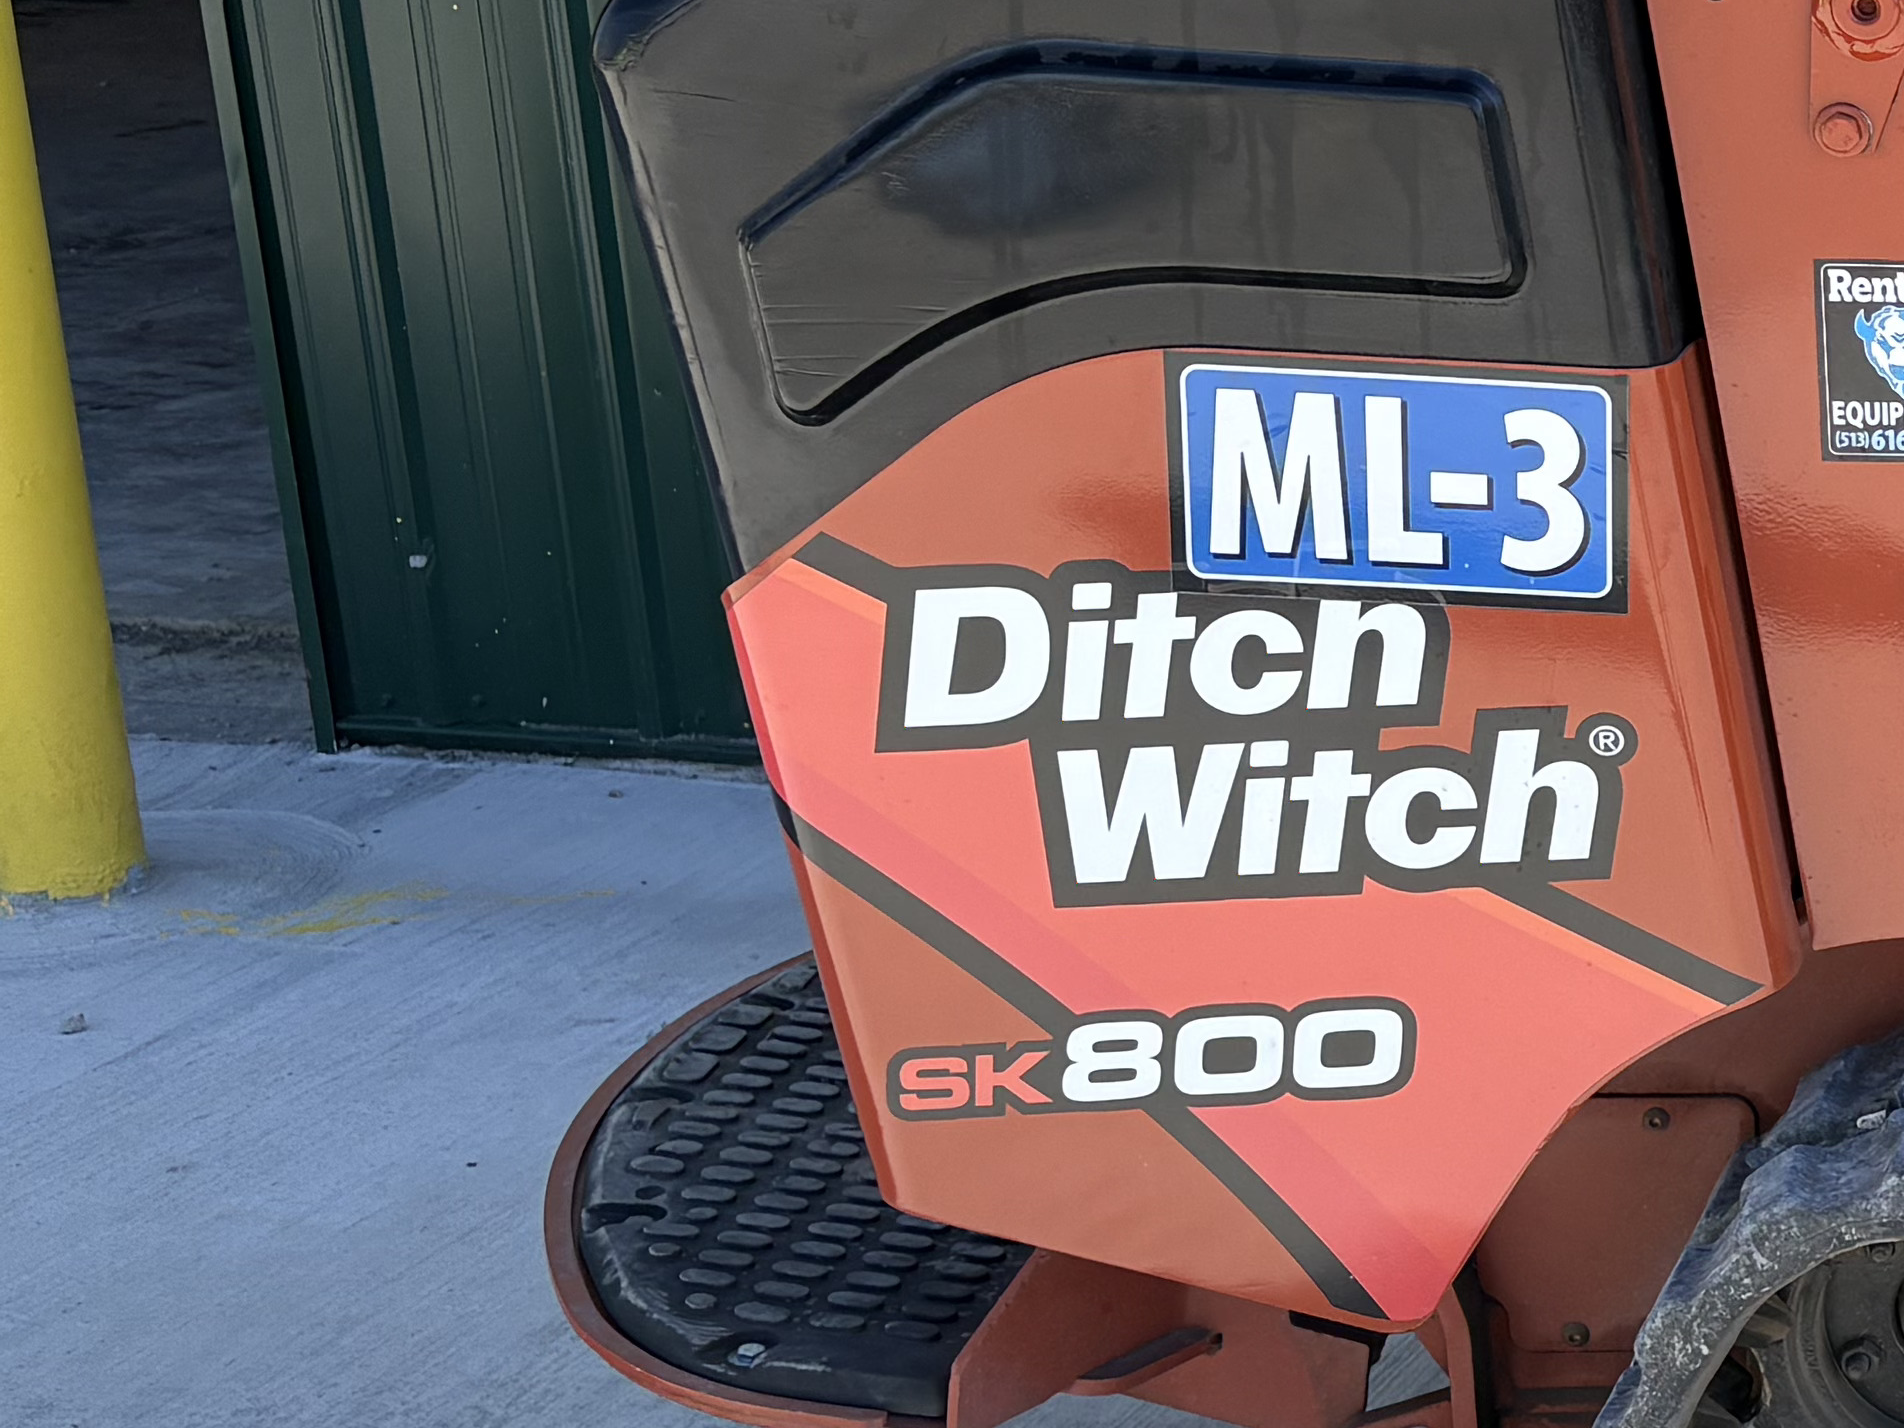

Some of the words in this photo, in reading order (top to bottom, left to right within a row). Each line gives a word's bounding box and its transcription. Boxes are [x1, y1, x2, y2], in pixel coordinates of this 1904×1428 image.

[1208, 387, 1592, 574] ML-3
[1835, 430, 1870, 449] (513)
[899, 1008, 1404, 1112] SK800
